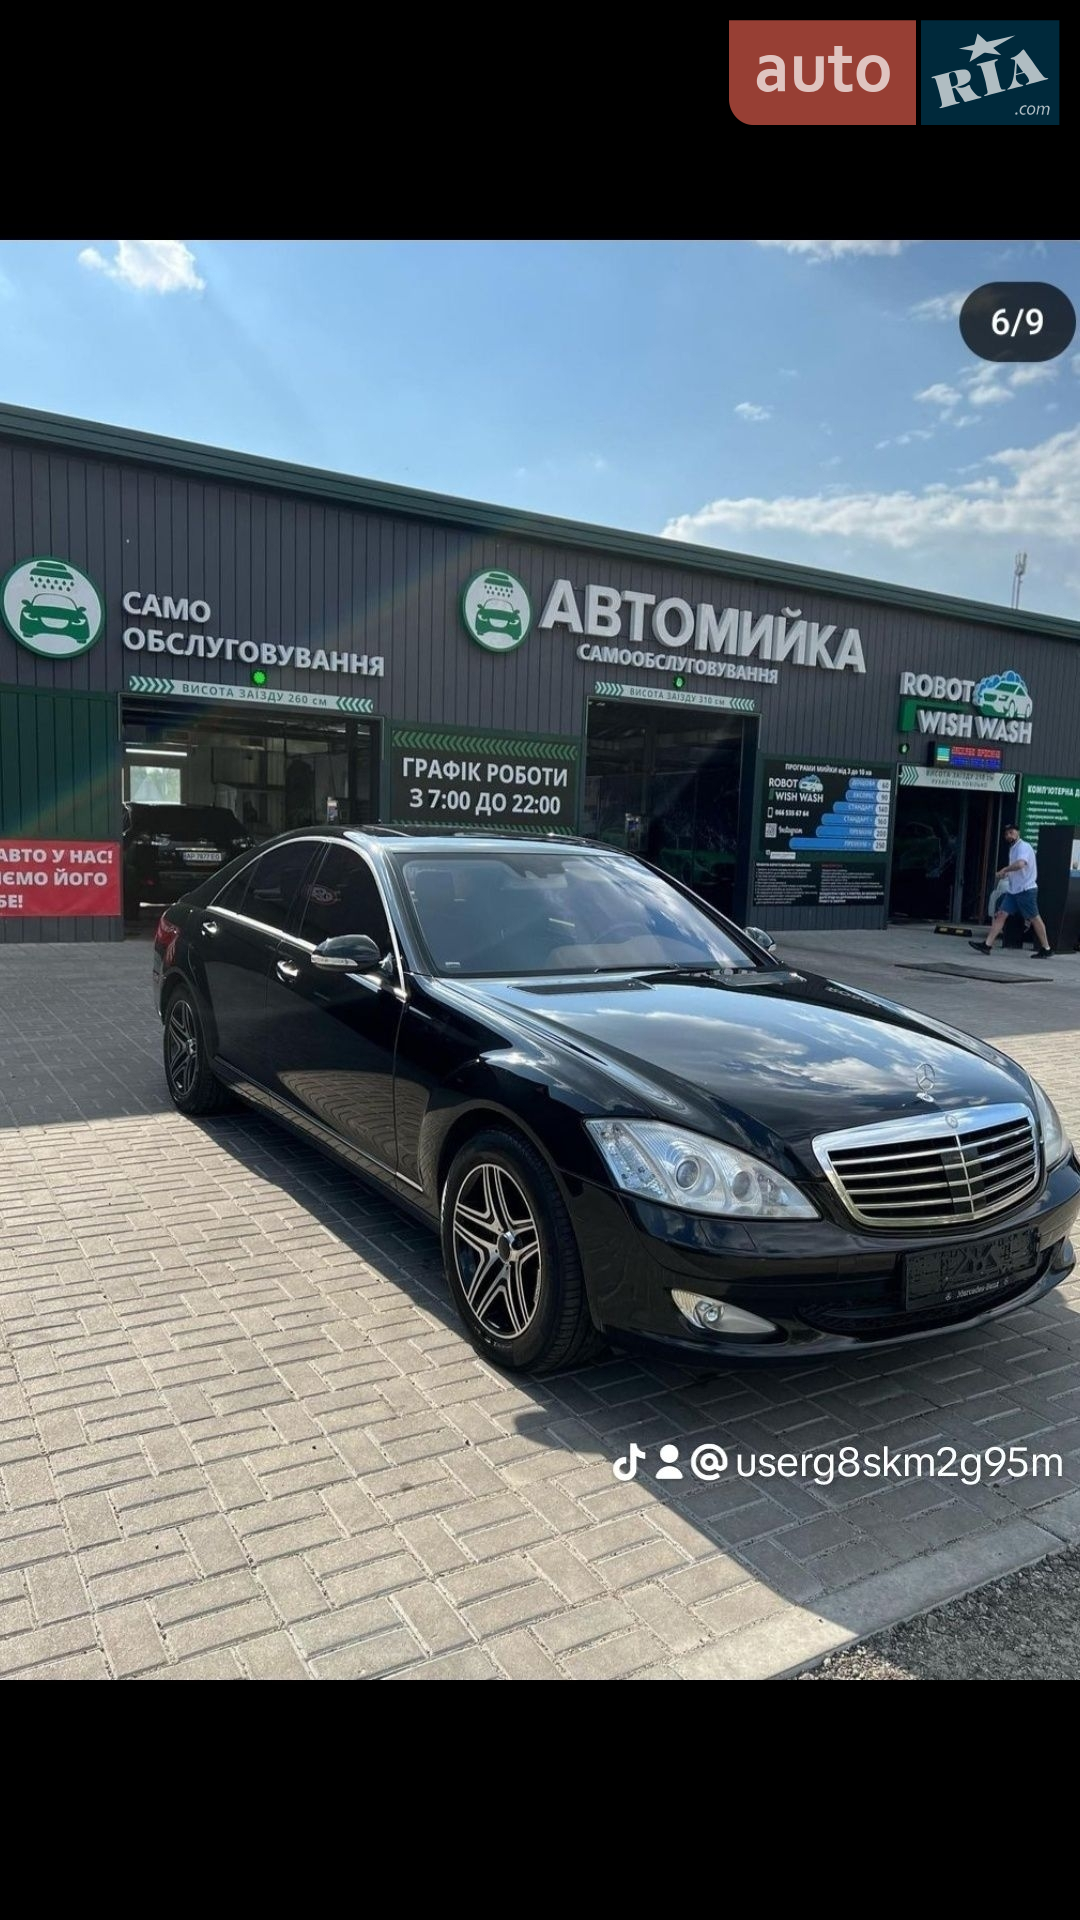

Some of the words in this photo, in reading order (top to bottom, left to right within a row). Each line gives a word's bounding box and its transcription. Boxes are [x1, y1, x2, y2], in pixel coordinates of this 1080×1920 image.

[123, 591, 212, 623] САМО
[538, 579, 866, 673] АВТОМИЙКА
[123, 627, 385, 677] ОБСЛУГОВУВАННЯ
[577, 643, 778, 684] САМООБСЛУГОВУВАННЯ
[182, 683, 234, 697] ВИСОТА
[289, 692, 308, 705] 260
[630, 687, 664, 700] ВИСОТА
[698, 695, 713, 705] 310
[900, 671, 975, 703] ROBOT
[917, 709, 973, 738] WISH
[974, 716, 1033, 744] WASH
[403, 757, 481, 782] ГРАФІК
[487, 763, 568, 787] РОБОТИ
[785, 763, 816, 772] ПРОГРАМИ
[816, 764, 838, 774] МИЙКИ
[769, 777, 799, 788] ROBOT
[428, 789, 471, 811] 7:00
[475, 792, 507, 816] ДО
[512, 794, 561, 815] 22:00
[775, 791, 798, 802] WISH
[799, 792, 824, 803] WASH
[52, 849, 65, 864] У
[69, 850, 113, 864] НАС!
[0, 871, 48, 886] ЄМО
[54, 868, 108, 886] ЙОГО
